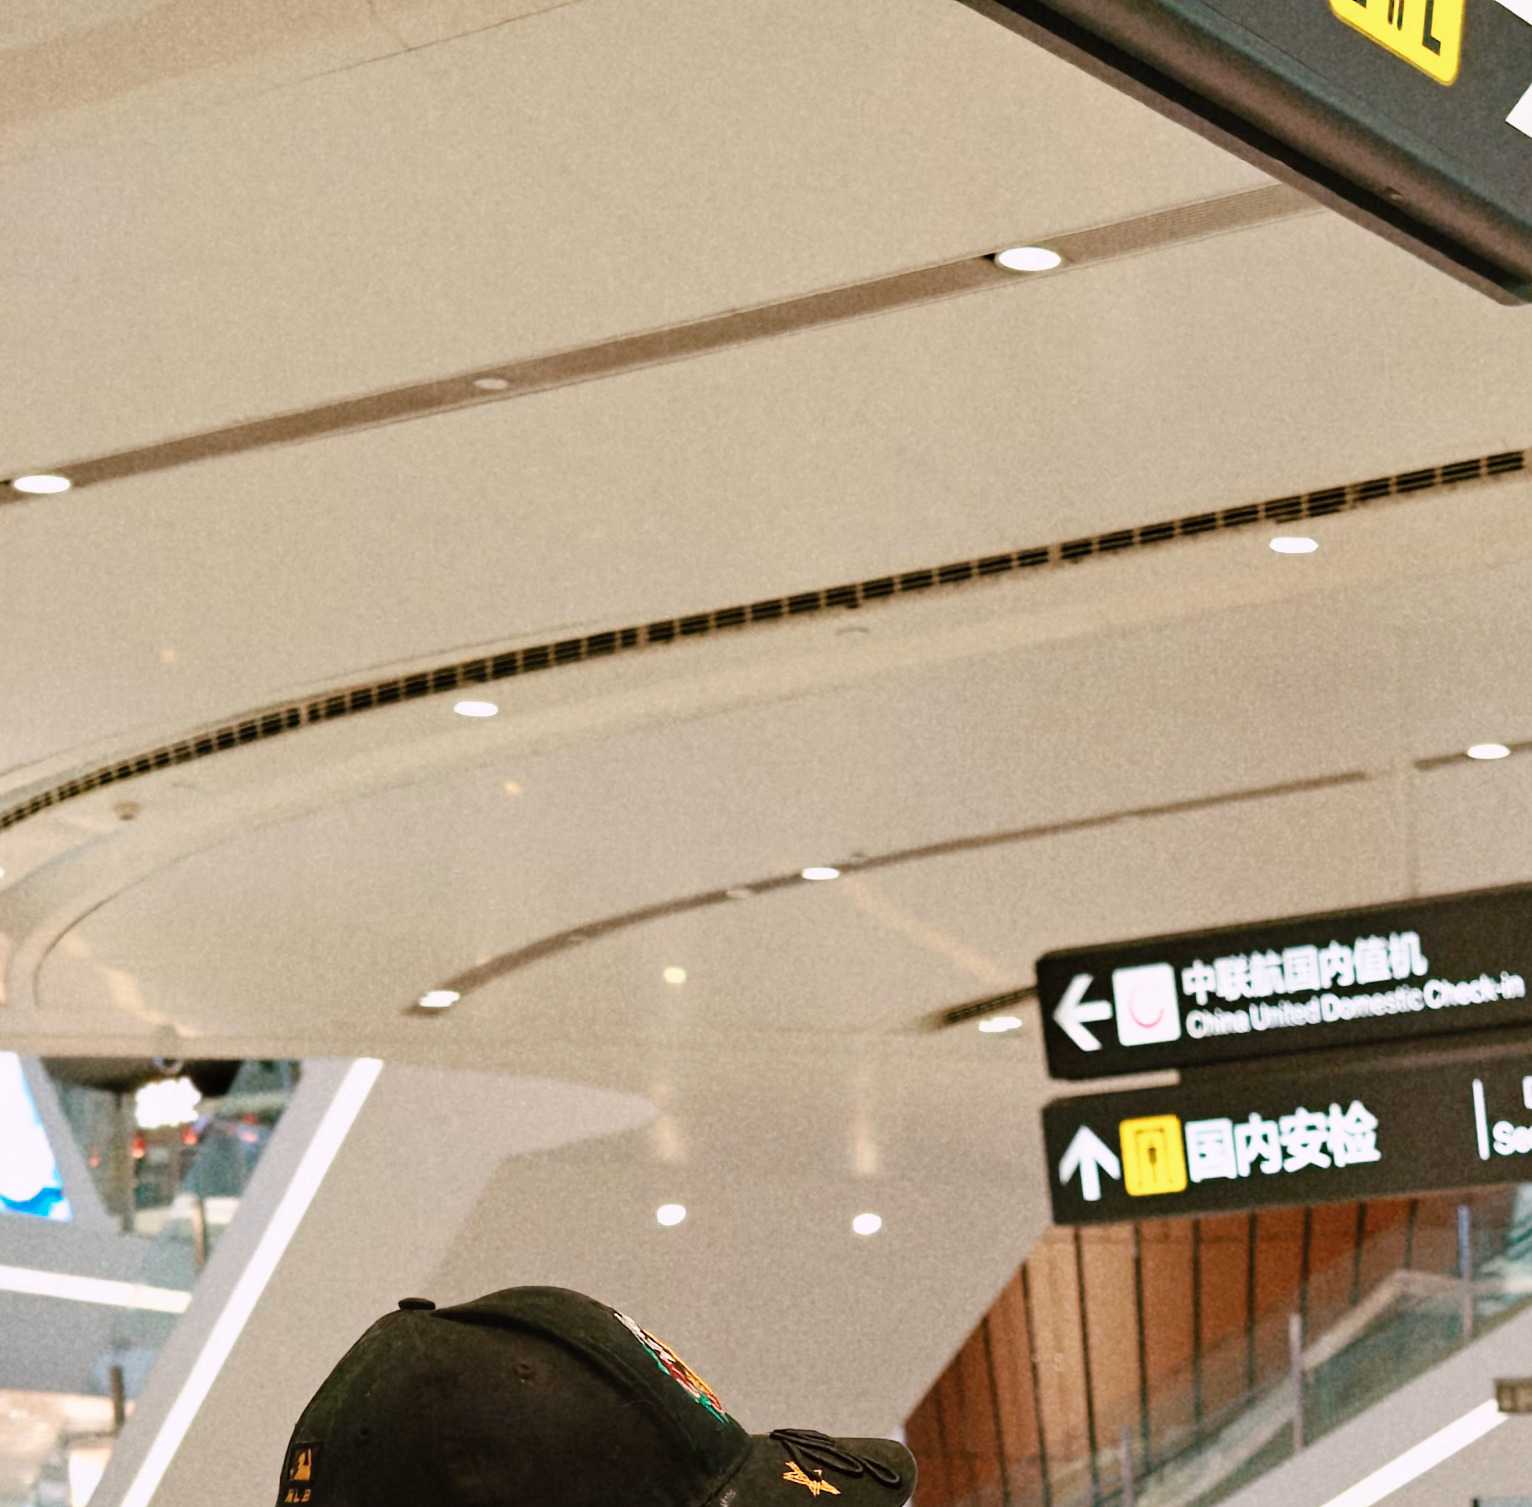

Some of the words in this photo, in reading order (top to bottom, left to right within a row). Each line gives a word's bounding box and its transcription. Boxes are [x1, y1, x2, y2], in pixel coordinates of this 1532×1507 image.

[1182, 931, 1428, 1004] 中联航国内值机
[1186, 1005, 1250, 1038] China
[1250, 997, 1321, 1031] United
[1322, 986, 1423, 1023] Domestic
[1423, 972, 1525, 1010] Check-in
[1185, 1101, 1381, 1182] 国内安检
